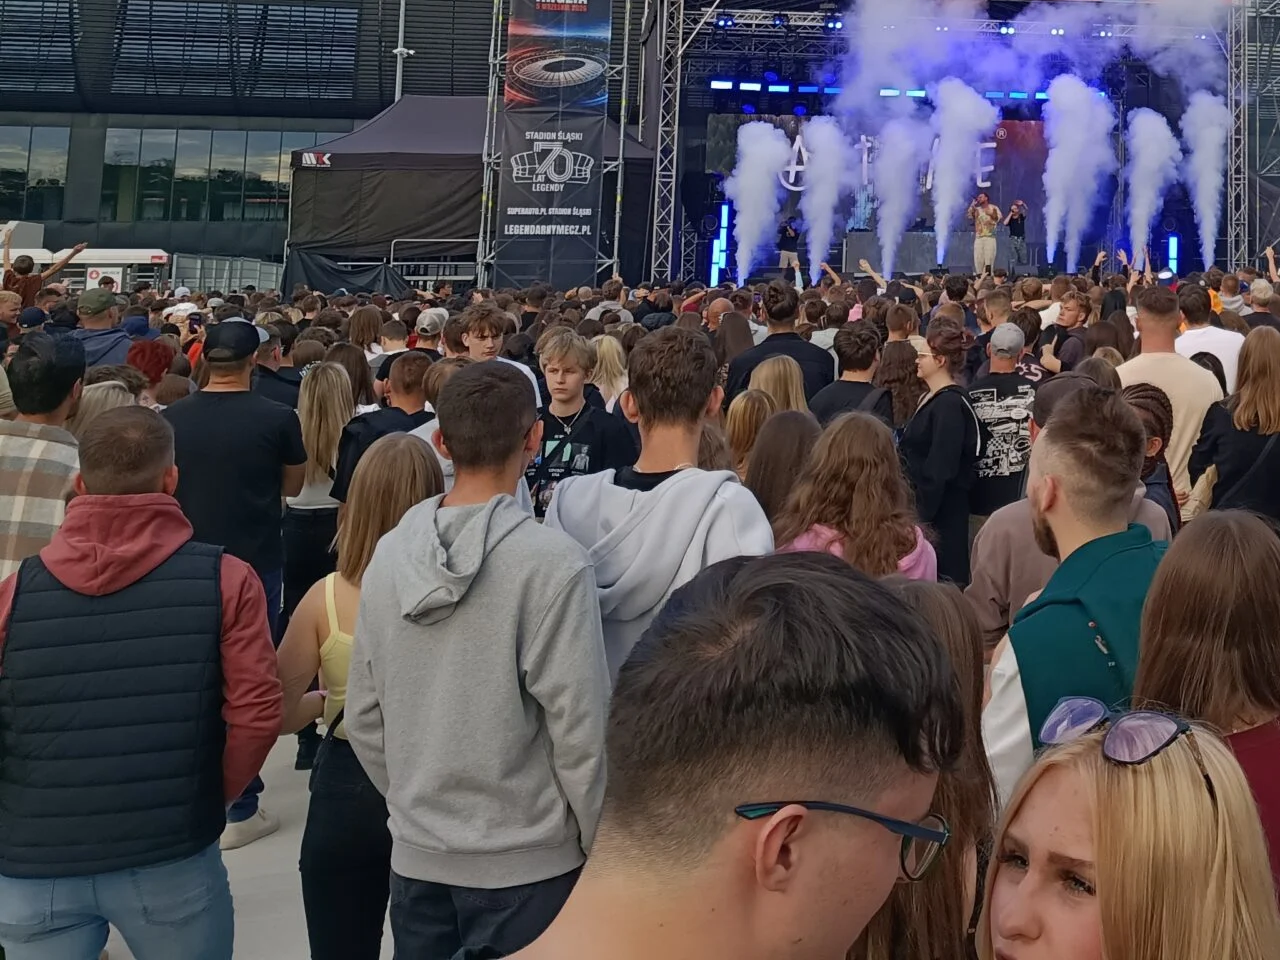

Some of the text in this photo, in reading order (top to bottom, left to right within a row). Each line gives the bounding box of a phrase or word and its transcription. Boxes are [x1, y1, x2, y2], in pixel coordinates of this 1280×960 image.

[525, 130, 583, 143] STADION ŚLĄSKI
[533, 141, 574, 182] 70
[532, 174, 546, 182] LAT
[532, 183, 565, 192] LEGENDY
[504, 224, 592, 235] LEGENDARNYMECZ.PL
